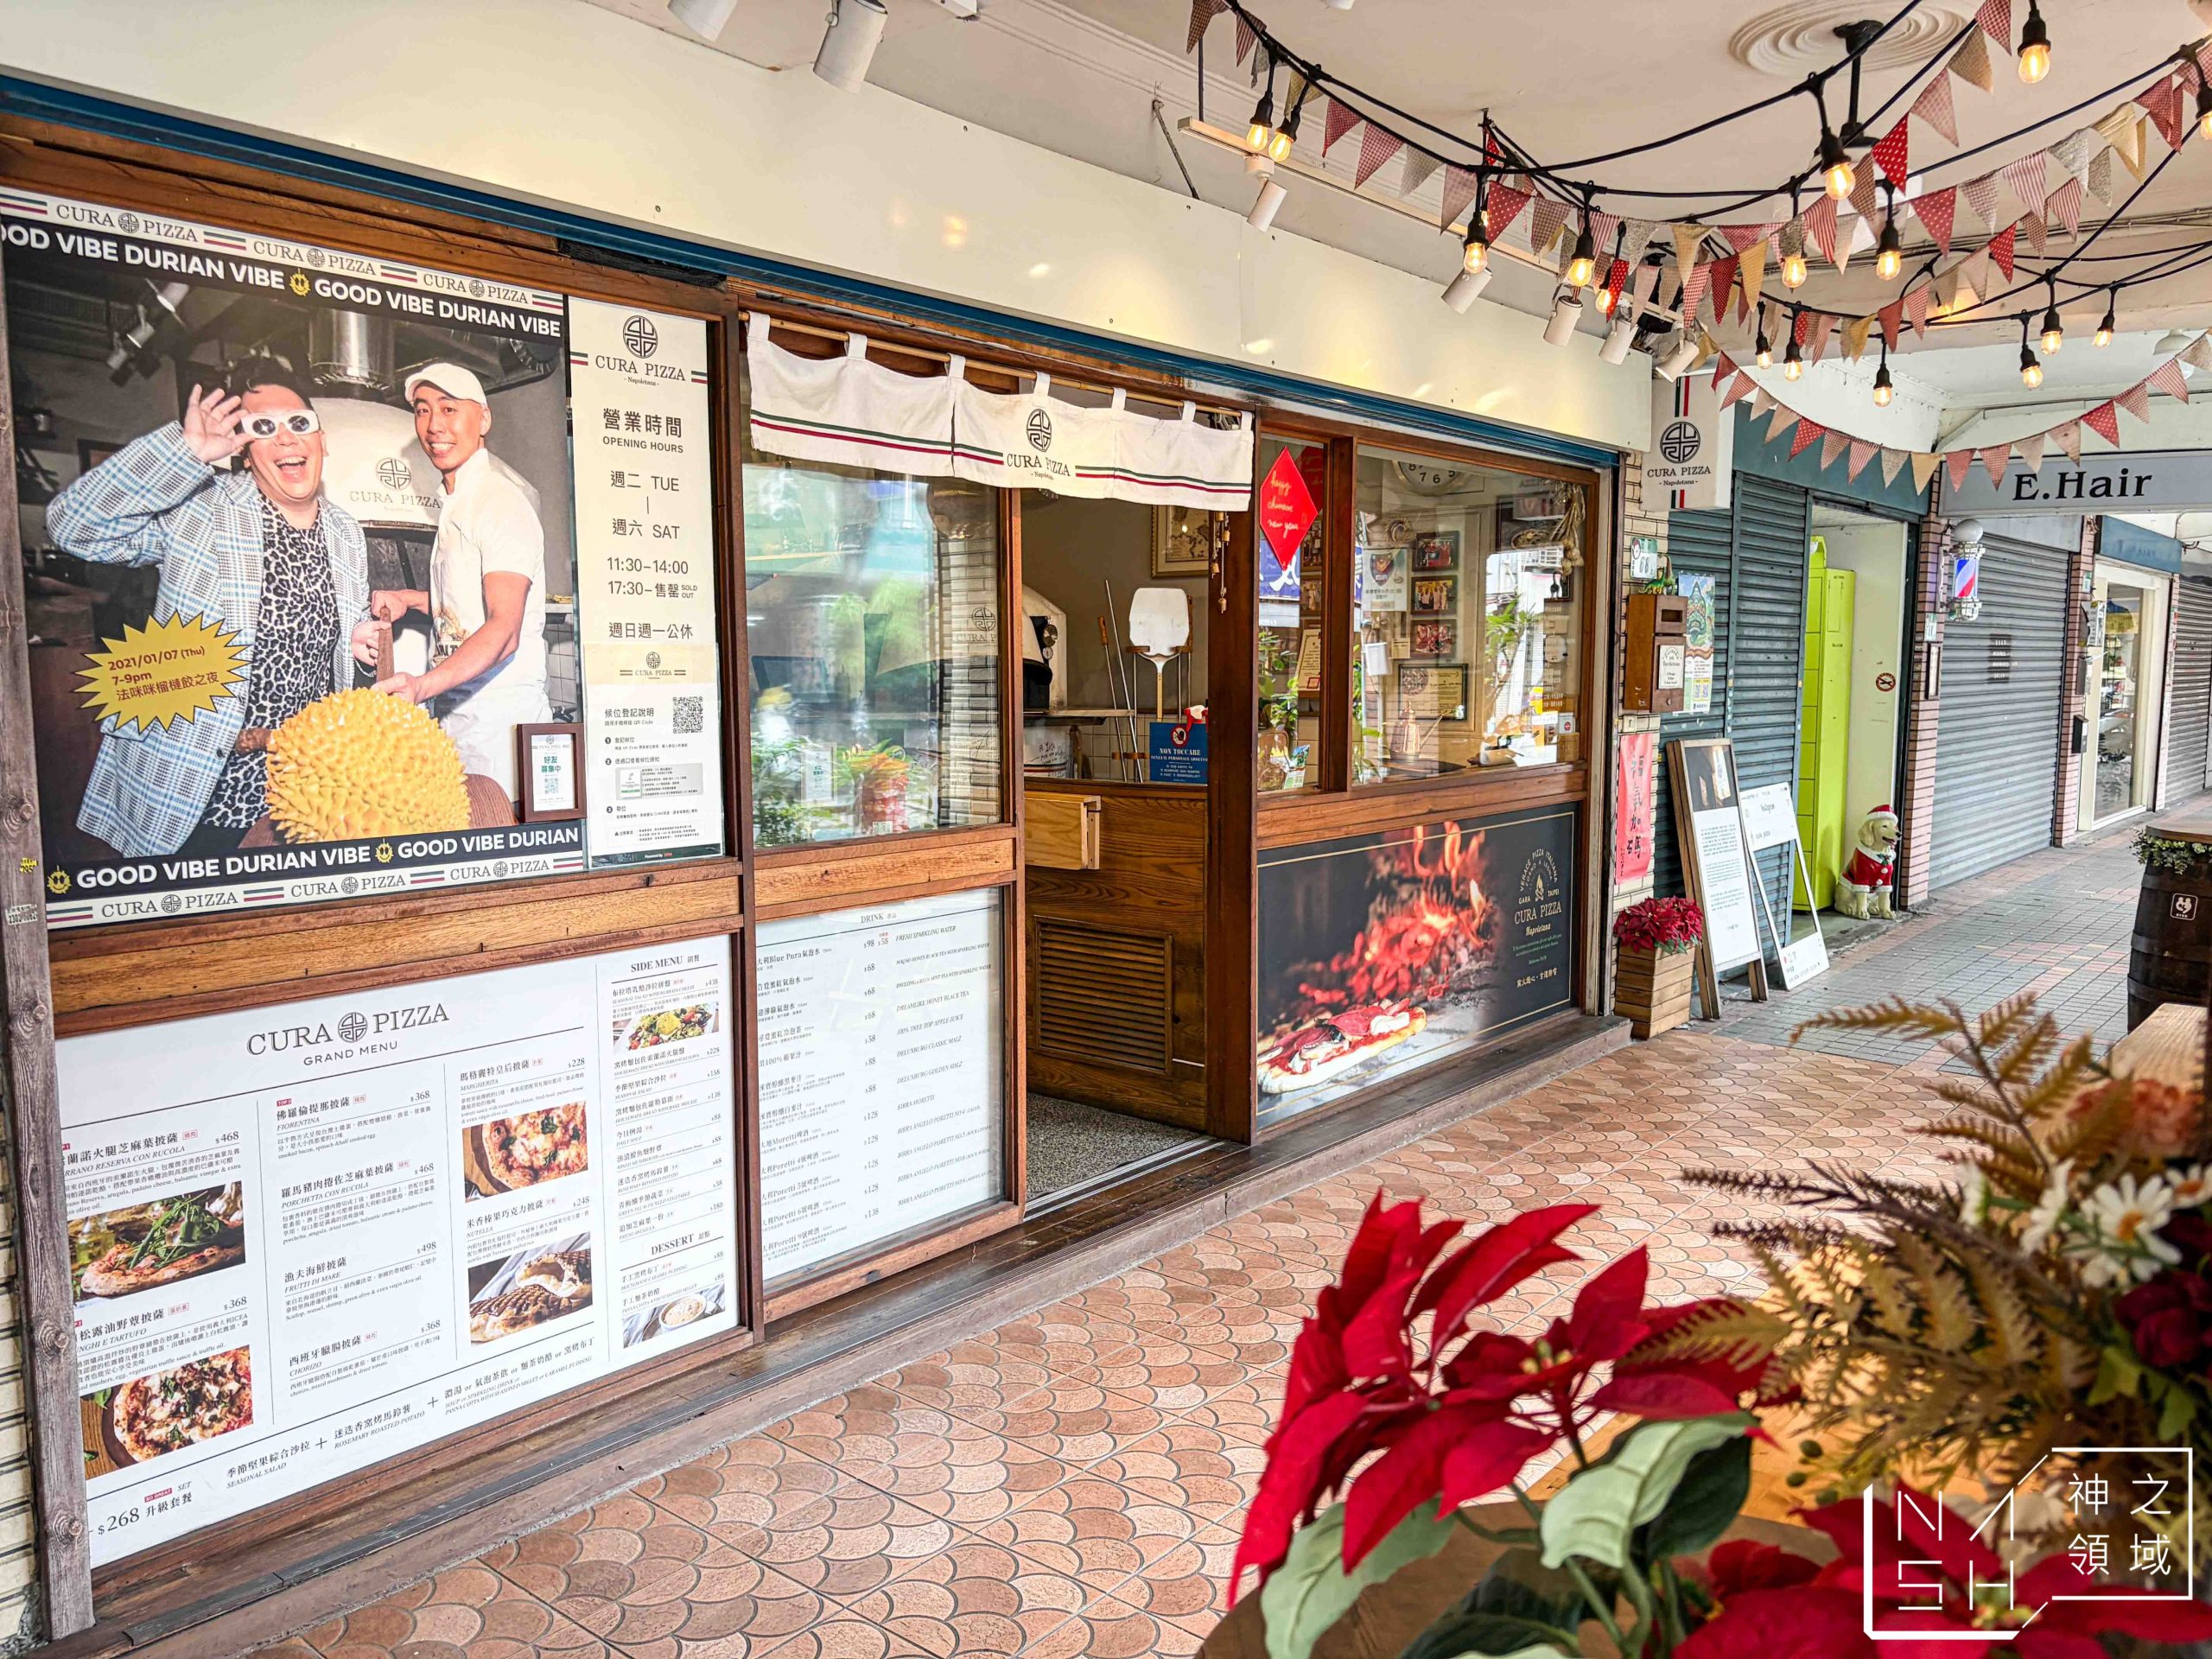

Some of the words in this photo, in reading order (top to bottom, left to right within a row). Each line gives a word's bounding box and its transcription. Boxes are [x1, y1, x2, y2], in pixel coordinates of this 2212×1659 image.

[56, 204, 114, 227] CURA
[143, 219, 198, 242] PIZZA
[253, 240, 302, 262] CURA
[328, 254, 376, 276] PIZZA
[423, 275, 467, 293] CURA
[486, 287, 529, 304] PIZZA
[56, 232, 119, 262] VIBE
[124, 245, 225, 280] DURIAN
[229, 262, 285, 290] VIBE
[315, 279, 382, 306] GOOD
[386, 291, 435, 316] VIBE
[439, 300, 516, 330] DURIAN
[518, 315, 561, 338] VIBE
[595, 355, 638, 374] CURA
[645, 363, 686, 382] PIZZA
[602, 408, 682, 438] 營業時間
[602, 436, 647, 449] OPENING
[650, 442, 683, 454] HOURS
[1007, 454, 1042, 467] CURA
[610, 470, 641, 489] 週二
[651, 476, 679, 492] TUE
[1420, 472, 1427, 481] 7
[1433, 474, 1440, 483] 6
[1647, 467, 1676, 478] CURA
[1681, 466, 1711, 476] PIZZA
[2012, 468, 2153, 501] E.Hair
[349, 491, 393, 504] CURA
[401, 493, 442, 509] PIZZA
[612, 518, 643, 537] 週六
[652, 524, 680, 539] SAT
[608, 622, 693, 639] 週日週一公休
[108, 649, 178, 671] 2021/01/07
[181, 645, 206, 659] (Thu)
[111, 671, 152, 685] 7-9pm
[605, 708, 654, 718] 候位登記說明
[77, 866, 156, 889] GOOD
[162, 859, 219, 880] VIBE
[226, 850, 316, 874] DURIAN
[321, 846, 371, 867] VIBE
[398, 839, 457, 859] GOOD
[462, 834, 505, 851] VIBE
[510, 828, 578, 848] DURIAN
[101, 900, 158, 918] CURA
[186, 892, 238, 909] PIZZA
[291, 880, 338, 898] CURA
[361, 874, 405, 890] PIZZA
[450, 866, 491, 880] CURA
[511, 860, 550, 874] PIZZA
[861, 912, 884, 924] DRINK
[1514, 907, 1537, 925] CURA
[1540, 901, 1562, 918] PIZZA
[631, 961, 653, 972] SIDE
[655, 956, 683, 969] MENU
[247, 1023, 333, 1056] CURA
[372, 1002, 449, 1034] PIZZA
[303, 1049, 354, 1066] GRAND
[359, 1040, 398, 1057] MENU
[410, 1090, 430, 1103] $368
[276, 1116, 321, 1132] FIORENTINA
[215, 1131, 239, 1144] $468
[95, 1158, 131, 1171] RESERVA
[132, 1153, 151, 1163] CON
[152, 1146, 185, 1159] RUCOLA
[414, 1163, 434, 1175] $468
[282, 1194, 323, 1209] PORCHETTA
[324, 1190, 340, 1199] CON
[340, 1182, 369, 1194] RUCOLA
[651, 1234, 695, 1255] DESSERT
[284, 1256, 346, 1283] 漁夫海鮮披薩
[416, 1242, 436, 1254] $498
[284, 1280, 310, 1294] FRUTTI
[321, 1272, 341, 1282] MARE
[78, 1308, 164, 1341] 松露油野蕈披薩
[224, 1296, 247, 1310] $368
[421, 1319, 441, 1332] $368
[77, 1340, 101, 1354] NGHI
[110, 1328, 147, 1344] TARTUFO
[289, 1361, 322, 1376] CHORIZO
[226, 1471, 264, 1490] SEASONAL
[264, 1462, 288, 1478] SALAD
[334, 1432, 370, 1449] ROSEMARY
[370, 1421, 400, 1436] ROASTED
[400, 1410, 425, 1425] POTATO
[226, 1440, 310, 1478] 季節堅果綜合沙拉
[177, 1481, 192, 1491] SET
[146, 1491, 193, 1517] 升級套餐
[97, 1507, 140, 1536] $268
